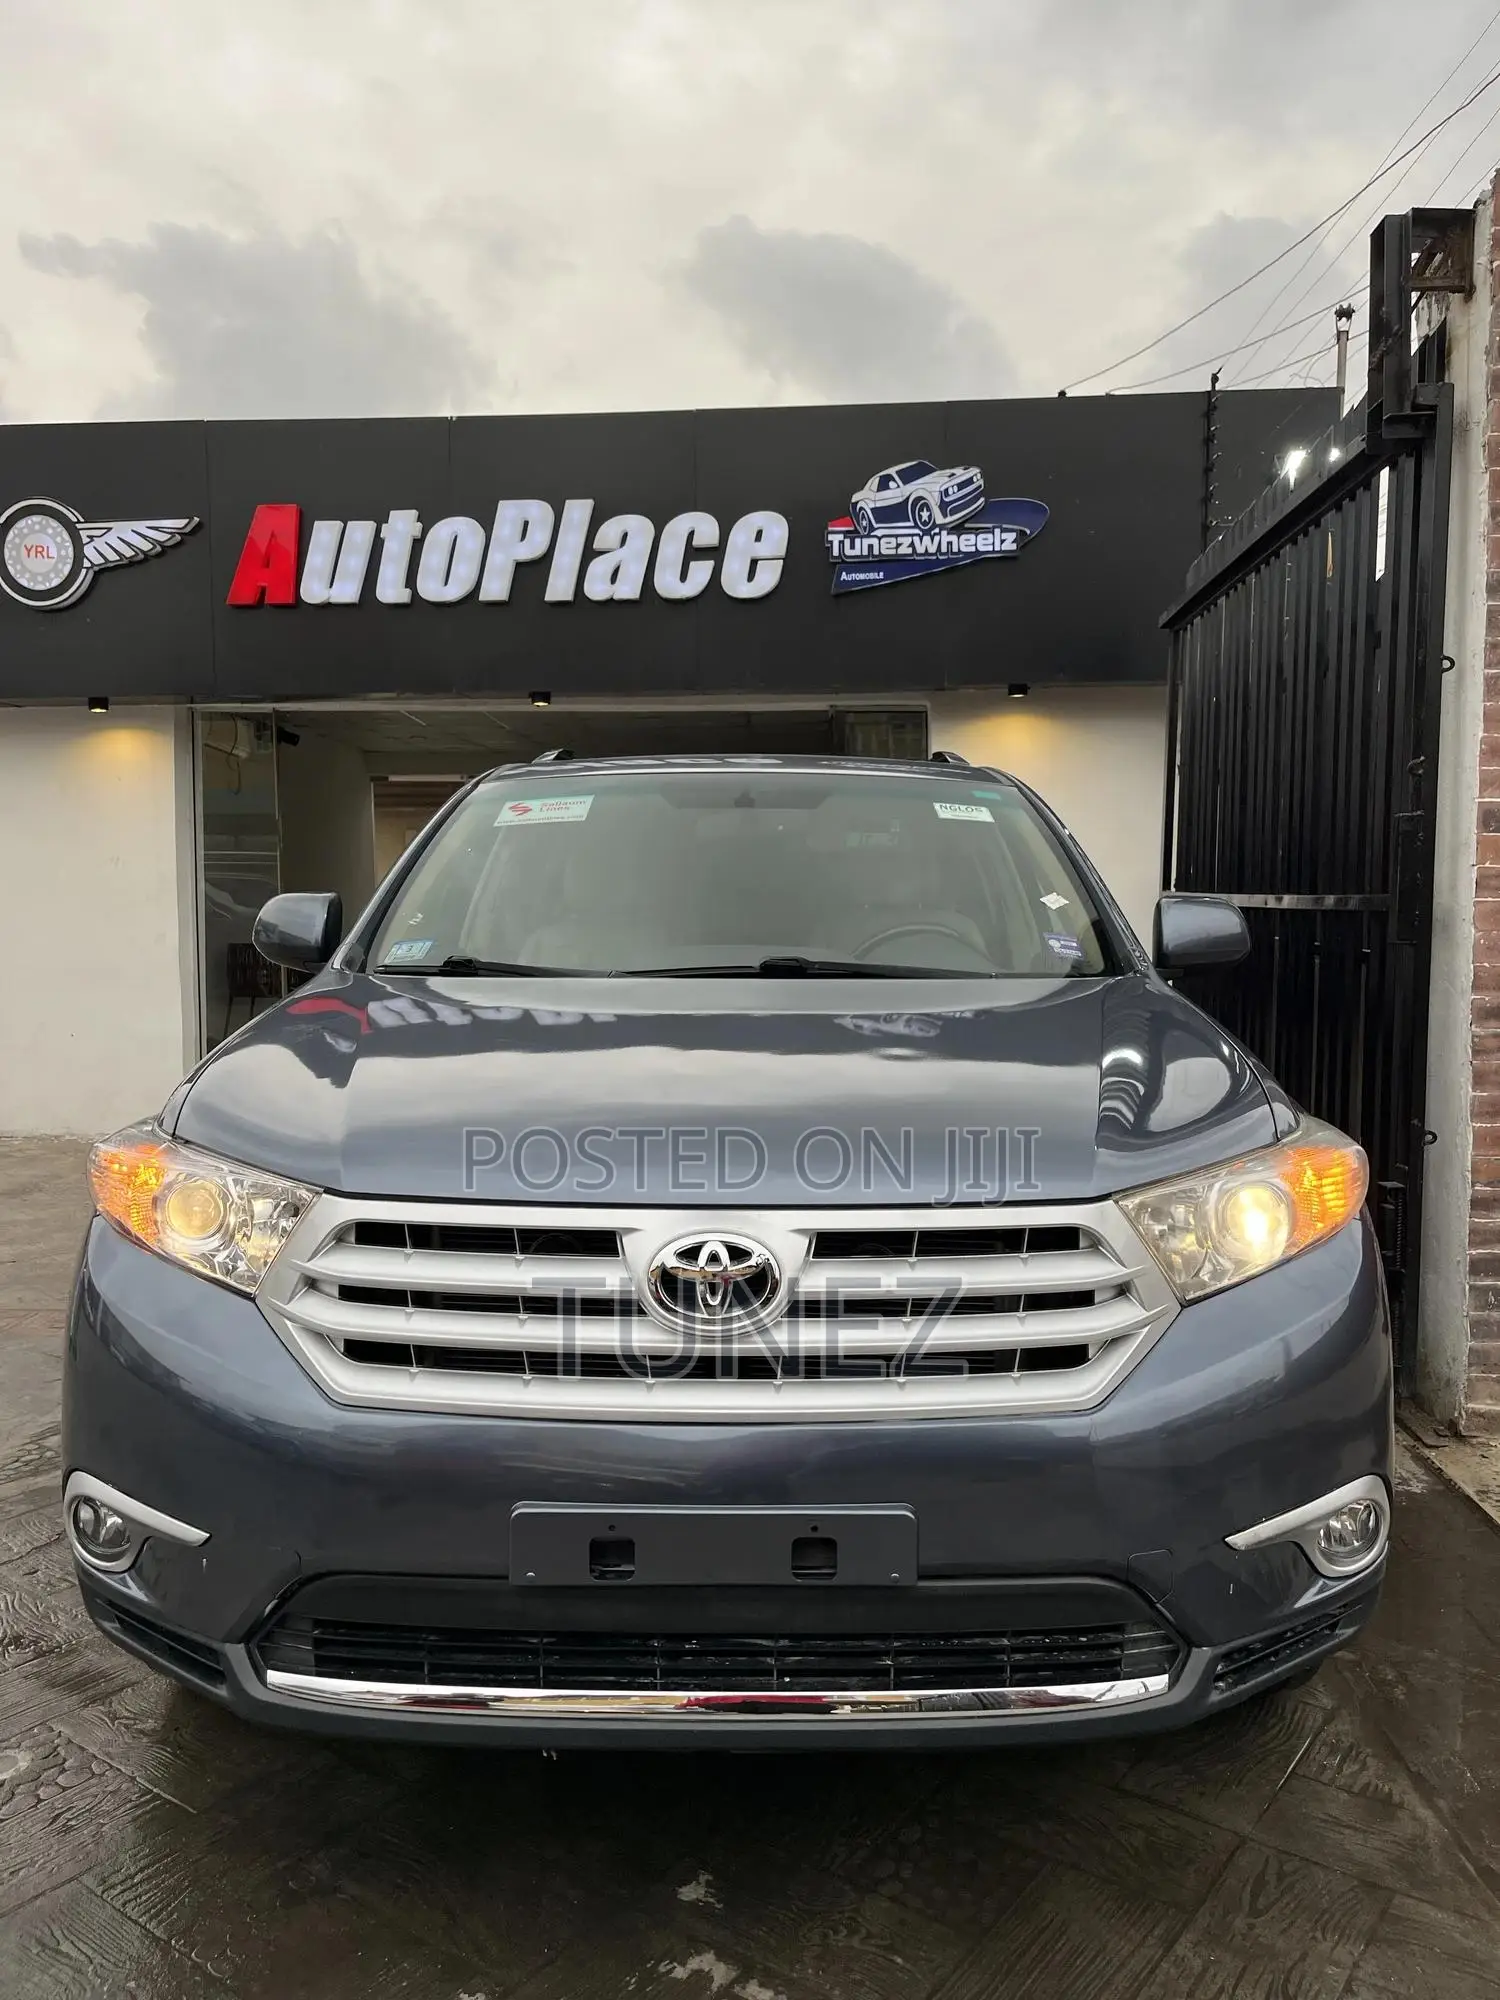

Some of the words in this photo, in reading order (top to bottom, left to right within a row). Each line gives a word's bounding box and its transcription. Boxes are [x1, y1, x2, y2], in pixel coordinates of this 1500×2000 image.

[24, 544, 56, 562] YRL
[226, 498, 791, 606] AutoPlace
[827, 528, 1018, 556] Tunezwheelz
